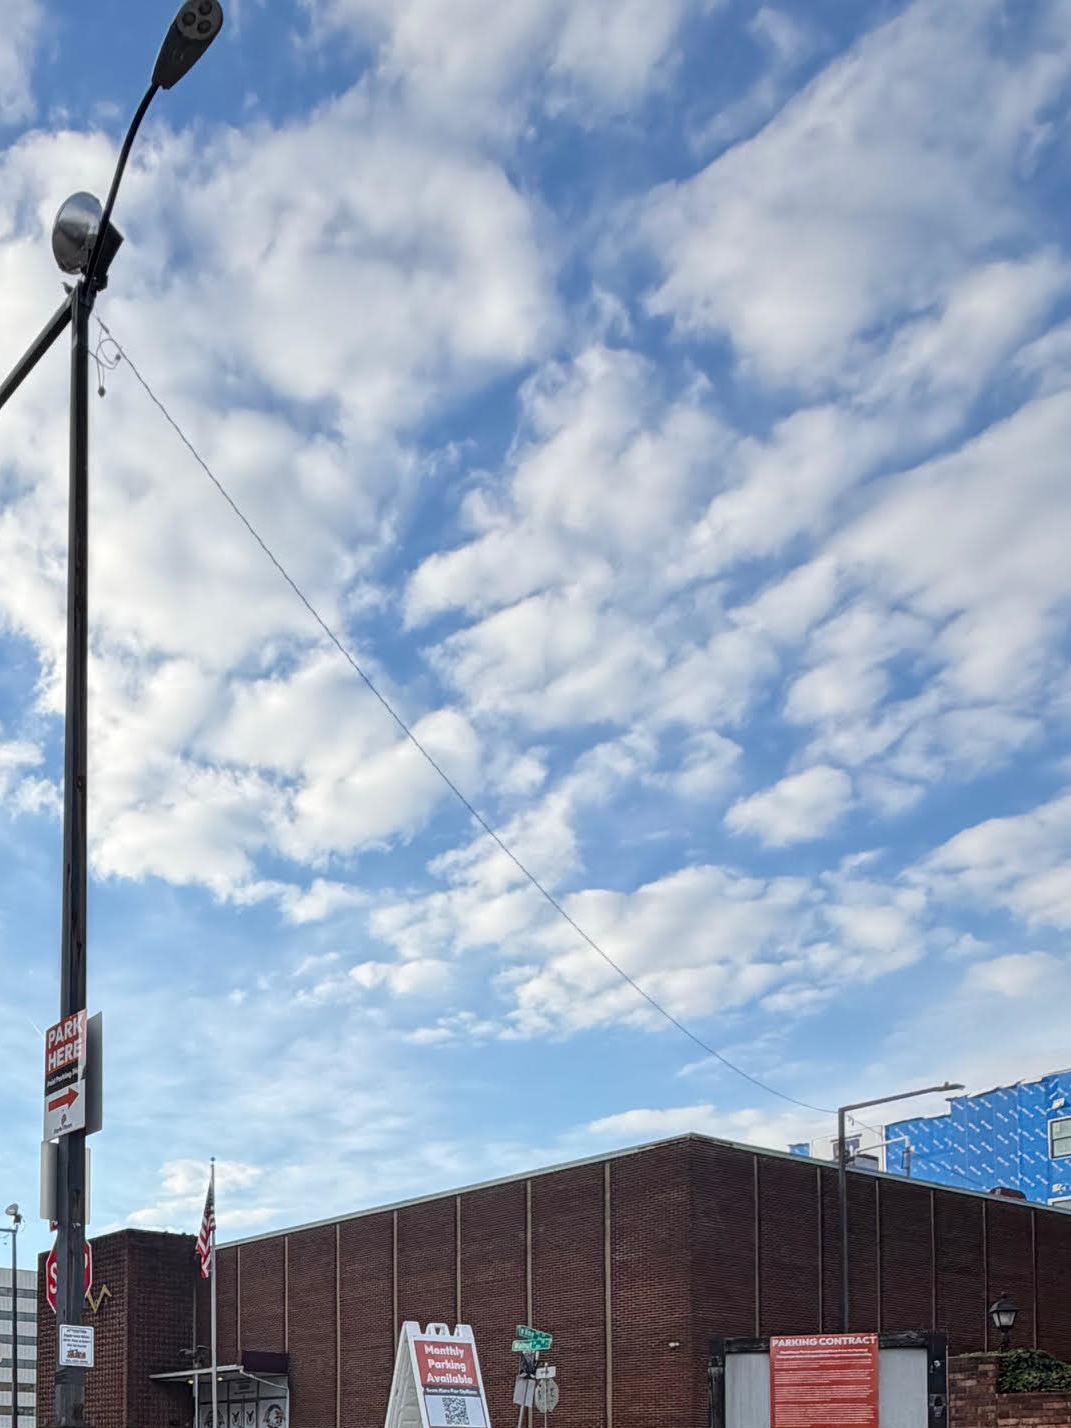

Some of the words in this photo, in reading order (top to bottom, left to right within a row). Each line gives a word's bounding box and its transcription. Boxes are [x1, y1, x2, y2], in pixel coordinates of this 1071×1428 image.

[48, 1014, 83, 1049] PARK
[48, 1039, 82, 1072] HERE
[772, 1338, 818, 1347] PARKING
[818, 1335, 878, 1346] CONTRACT
[424, 1344, 464, 1358] Monthly
[427, 1358, 466, 1372] Parking
[426, 1373, 473, 1384] Available
